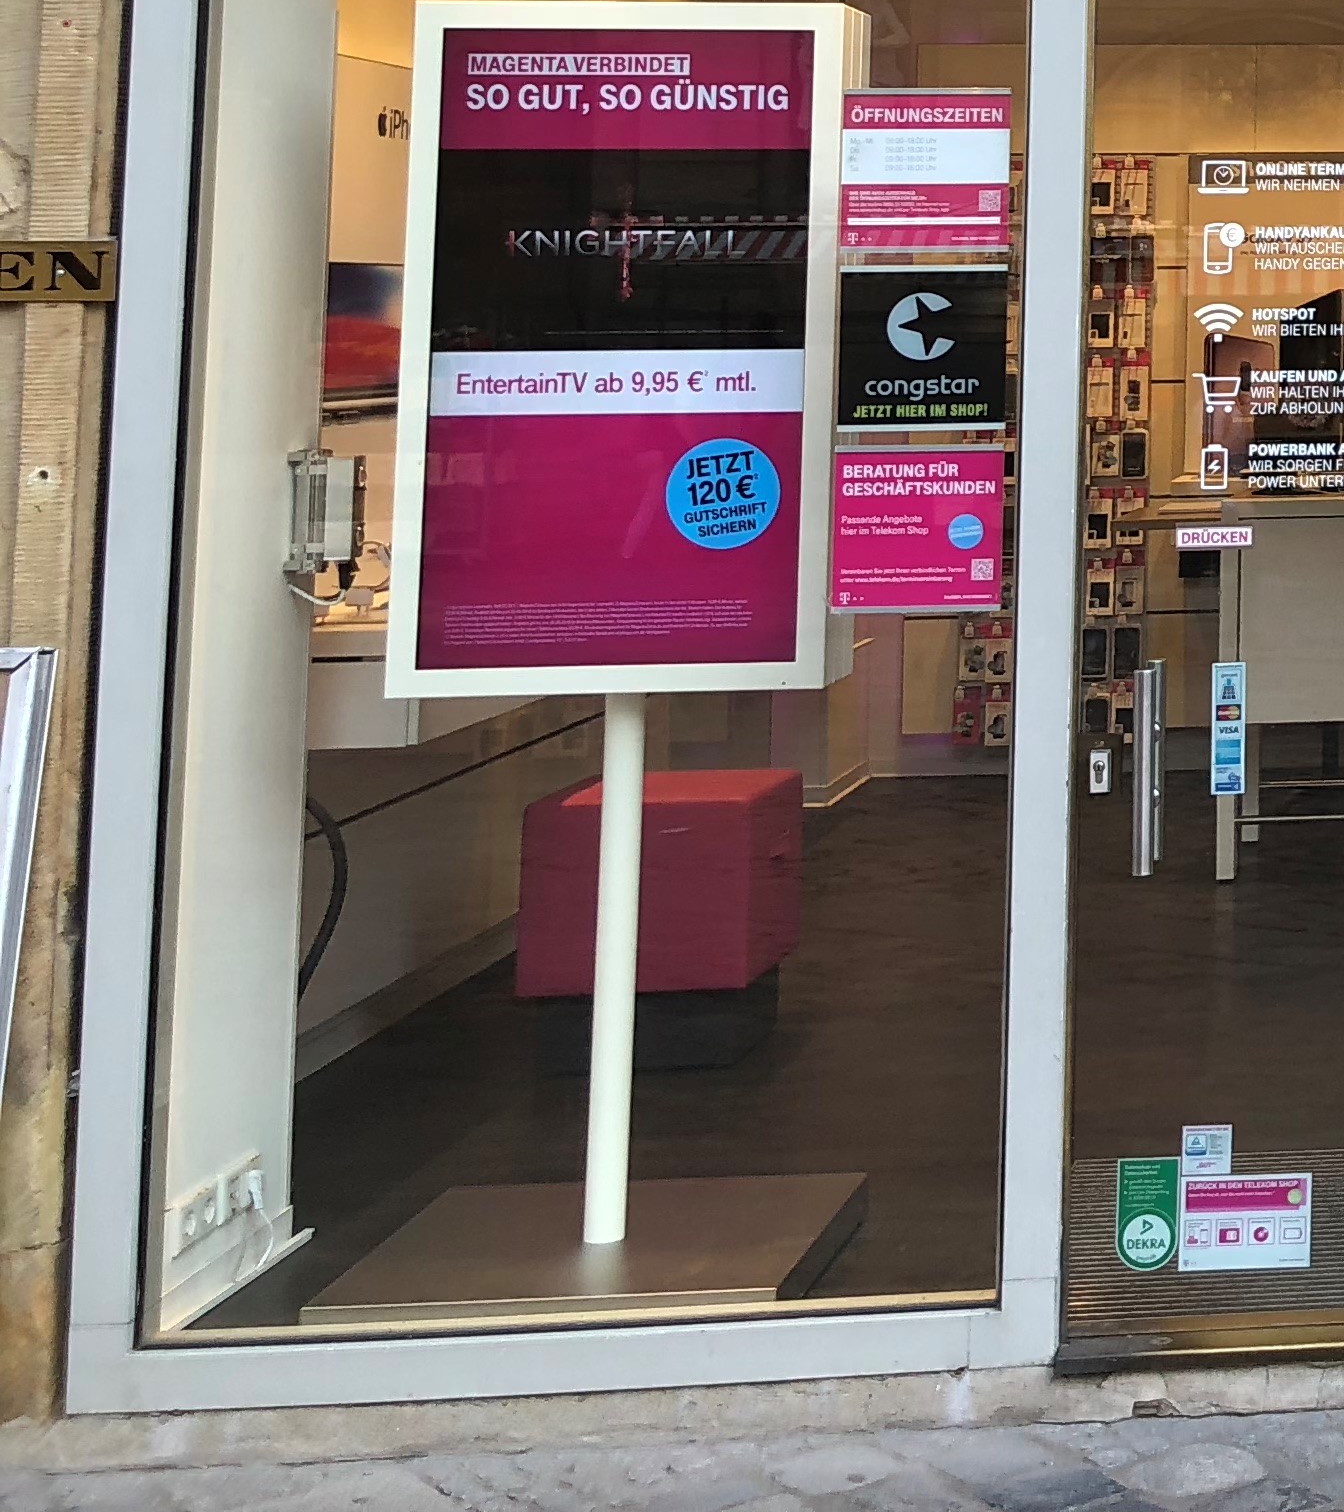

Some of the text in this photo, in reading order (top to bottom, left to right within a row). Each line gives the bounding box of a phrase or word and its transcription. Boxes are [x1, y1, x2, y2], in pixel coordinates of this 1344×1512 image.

[470, 55, 689, 74] MAGENTA VERBINDET
[466, 79, 789, 115] SO GUT, SO GÜNSTIG
[850, 105, 1003, 123] ÖFFNUNGSZEITEN
[388, 108, 411, 141] iPh
[1255, 163, 1307, 176] ONLINE
[1255, 178, 1281, 192] WIR
[1283, 178, 1341, 192] NEHMEN
[505, 230, 747, 257] KNIGHTFALL
[1254, 240, 1281, 255] WIR
[1254, 257, 1301, 270] HANDY
[1251, 308, 1317, 321] HOTSPOT
[1251, 323, 1277, 336] WIR
[1280, 323, 1328, 336] BIETEN
[455, 371, 589, 394] EntertainTV
[594, 371, 625, 394] ab
[631, 370, 679, 396] 9,95
[715, 370, 758, 392] mtl.
[1249, 369, 1304, 383] KAUFEN
[1307, 369, 1338, 383] UND
[864, 375, 981, 401] congstar
[1249, 385, 1276, 399] WIR
[1278, 385, 1330, 399] HALTEN
[852, 402, 989, 419] JETZT HIER IM SHOP!
[1249, 401, 1277, 415] ZUR
[1248, 442, 1336, 456] POWERBANK
[686, 450, 755, 480] JETZT
[842, 461, 960, 479] BERATUNG FÜR
[1248, 459, 1275, 472] WIR
[1276, 459, 1333, 472] SORGEN
[841, 479, 997, 497] GESCHÄFTSKUNDEN
[1247, 474, 1296, 489] POWER
[687, 477, 732, 507] 120
[683, 501, 768, 524] GUTSCHRIFT
[697, 518, 757, 538] SICHERN
[840, 514, 923, 527] Passende Angebote
[840, 525, 930, 538] hier im Telekom Shop
[1180, 527, 1250, 546] DRÜCKEN
[1218, 725, 1240, 735] VISA
[1126, 1238, 1167, 1251] DEKRA
